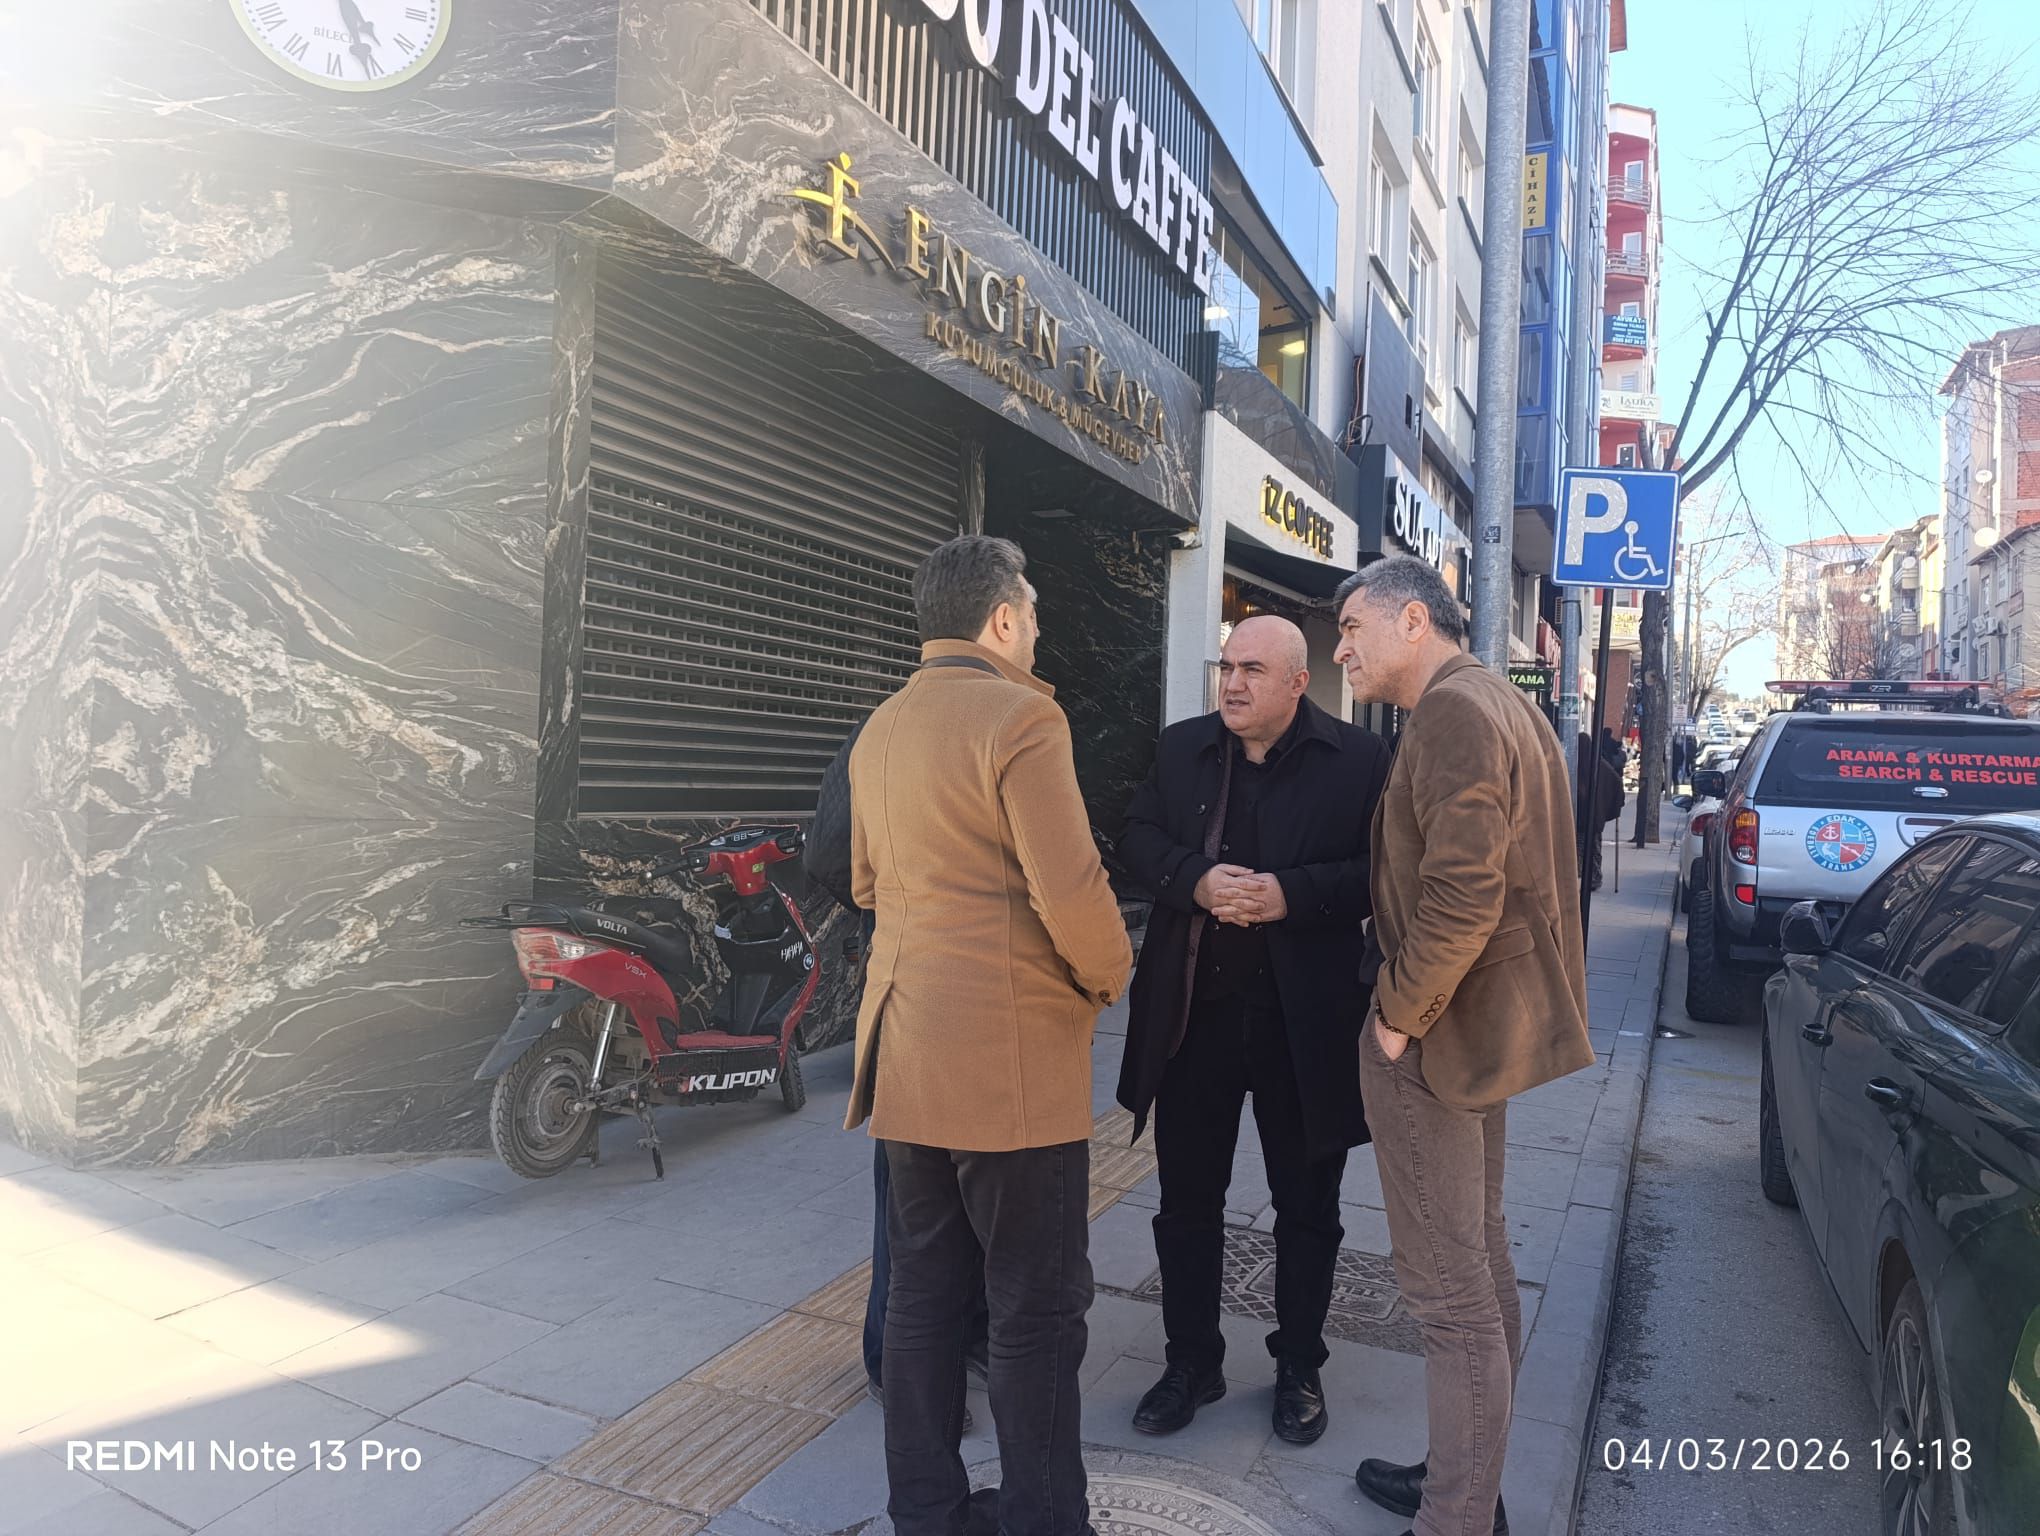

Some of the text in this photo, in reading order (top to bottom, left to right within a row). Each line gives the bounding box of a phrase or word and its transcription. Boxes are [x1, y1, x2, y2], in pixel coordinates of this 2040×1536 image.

[313, 25, 352, 44] BİLEC
[1016, 0, 1214, 297] DEL CAFFE
[1527, 157, 1538, 226] CİHAZI
[905, 205, 1165, 444] ENGİN KAYA
[926, 311, 1056, 411] KUYUMCULUK
[1071, 402, 1142, 464] MÜCEVHER
[1284, 491, 1334, 559] COFFEE
[1564, 477, 1628, 565] P
[1508, 674, 1545, 685] YAMA
[1826, 749, 2040, 768] ARAMA & KURTARMA
[1839, 765, 2038, 785] SEARCH & RESCUE
[1826, 815, 1856, 824] EDAK
[597, 918, 628, 935] VOLTA
[688, 1067, 777, 1093] KUPON
